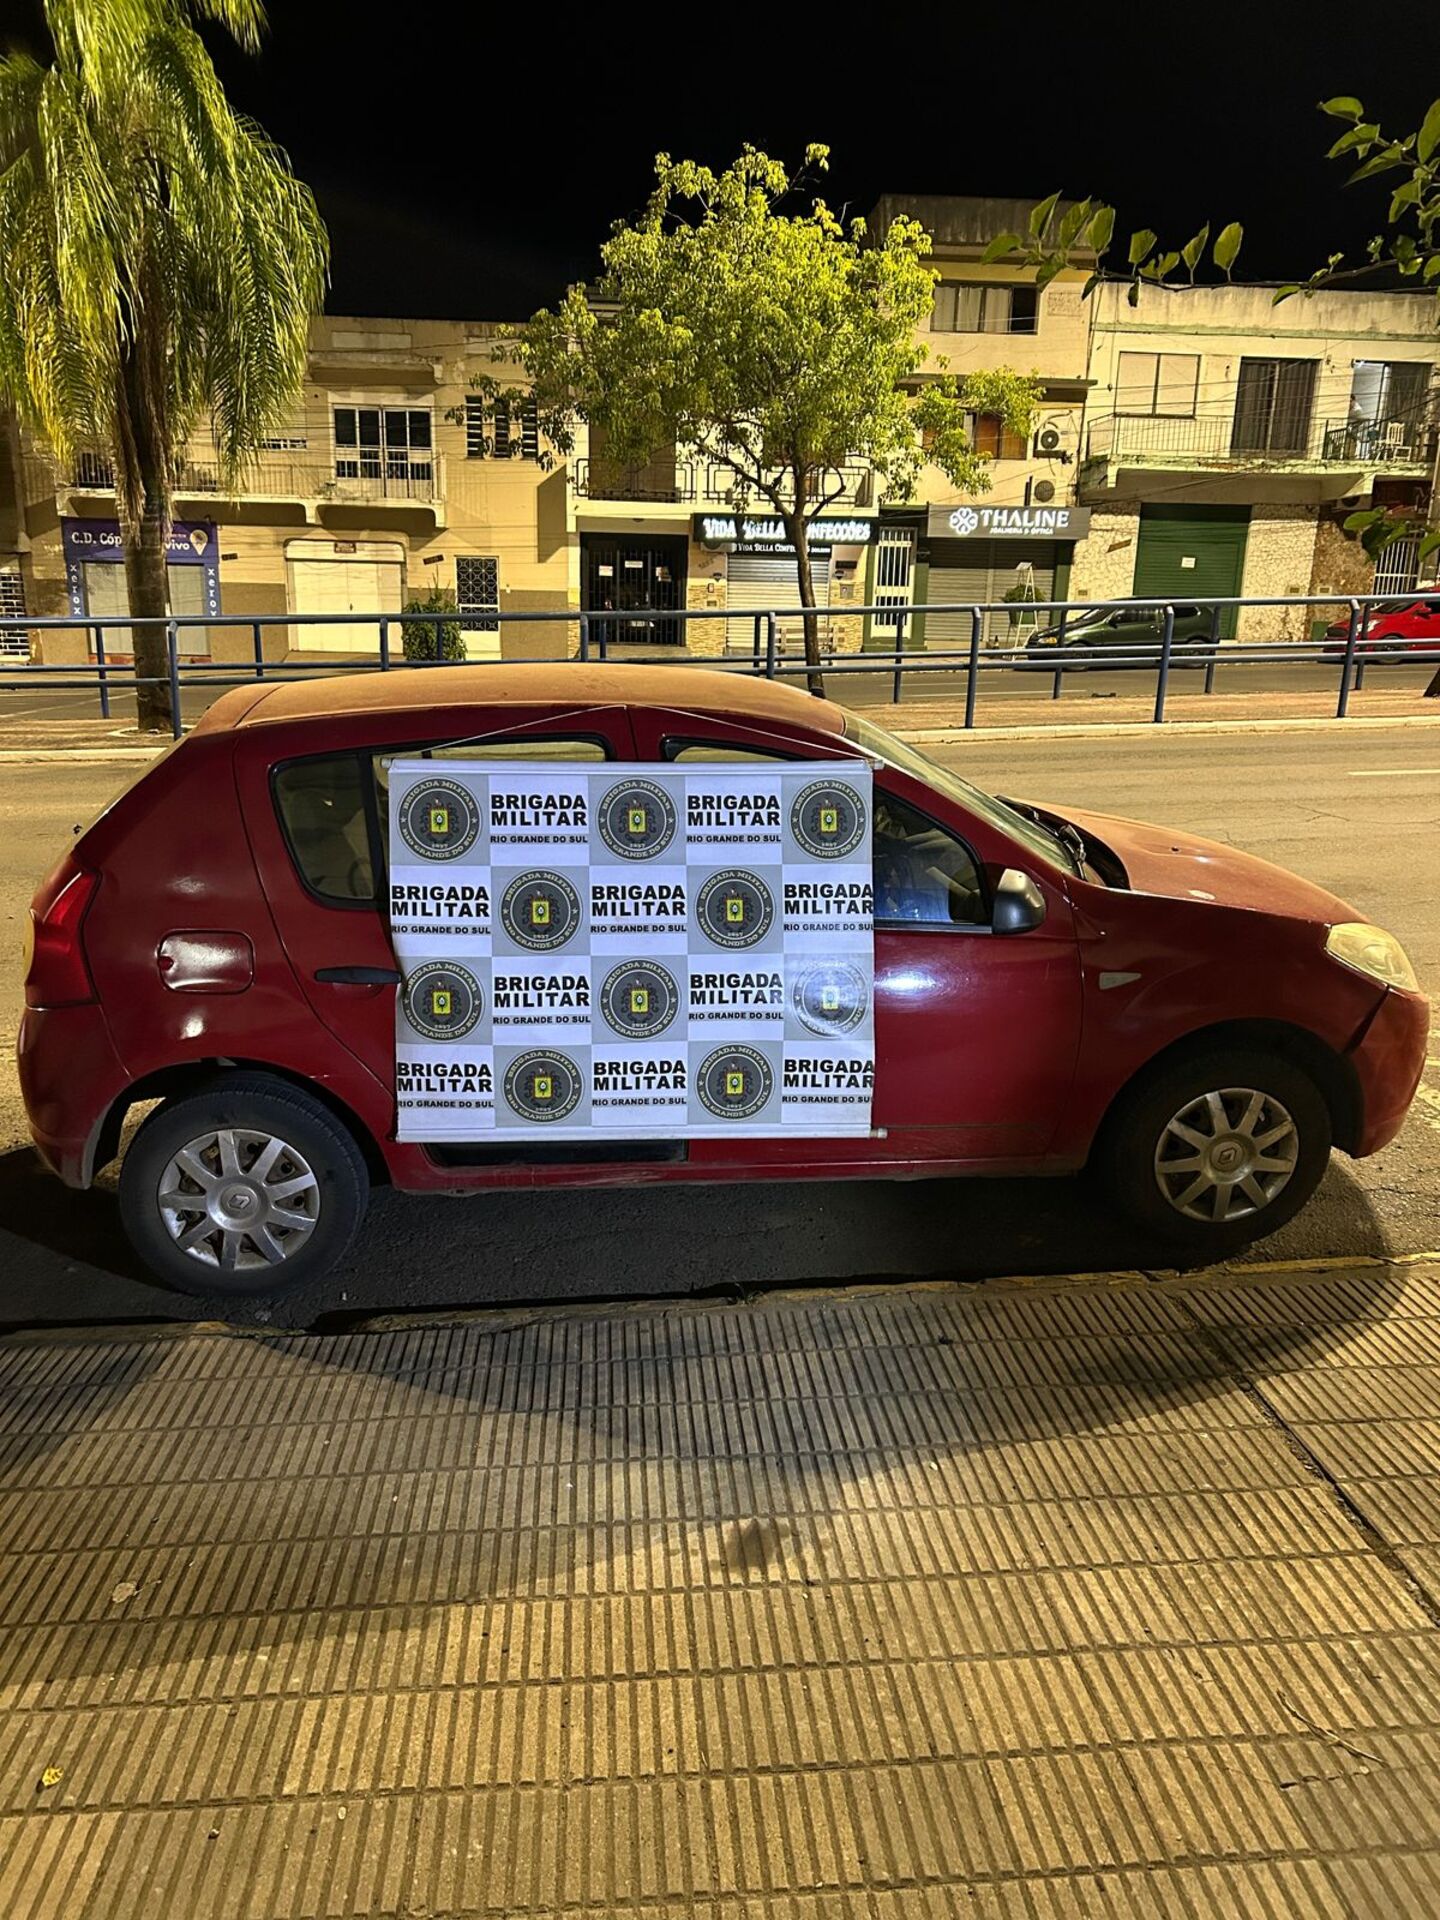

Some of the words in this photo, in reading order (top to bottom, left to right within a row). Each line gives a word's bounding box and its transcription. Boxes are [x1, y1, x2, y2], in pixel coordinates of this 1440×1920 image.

[980, 509, 1069, 527] THALINE
[703, 517, 737, 538] VIDA
[806, 520, 870, 540] NFECÇÕES
[71, 532, 96, 544] C.D.
[99, 532, 123, 546] Cóp
[738, 543, 753, 551] VIDA
[404, 781, 439, 810] BRIGADA
[441, 781, 474, 810] MILITAR
[492, 795, 586, 810] BRIGADA
[604, 782, 637, 810] BRIGADA
[639, 782, 671, 810] MILITAR
[687, 795, 781, 810] BRIGADA
[796, 782, 828, 809] BRIGADA
[830, 782, 861, 809] MILITAR
[492, 811, 587, 826] MILITAR
[687, 811, 781, 826] MILITAR
[490, 835, 507, 844] RIO
[510, 835, 549, 844] GRANDE
[553, 835, 566, 844] DO
[570, 835, 588, 844] SUL
[686, 834, 702, 843] RIO
[706, 834, 744, 843] GRANDE
[748, 834, 760, 843] DO
[764, 834, 782, 843] SUL
[391, 885, 490, 901] BRIGADA
[506, 872, 541, 901] BRIGADA
[543, 872, 575, 901] MILITAR
[592, 885, 686, 900] BRIGADA
[701, 872, 735, 900] BRIGADA
[737, 872, 769, 900] MILITAR
[784, 883, 873, 898] BRIGADA
[392, 901, 490, 917] MILITAR
[592, 901, 686, 917] MILITAR
[784, 899, 873, 914] MILITAR
[391, 925, 408, 934] RIO
[411, 925, 452, 934] GRANDE
[455, 925, 469, 934] DO
[472, 925, 491, 934] SUL
[591, 924, 607, 933] RIO
[610, 924, 648, 933] GRANDE
[652, 924, 665, 933] DO
[668, 924, 687, 933] SUL
[783, 923, 800, 931] RIO
[802, 923, 841, 931] GRANDE
[843, 923, 855, 931] DO
[445, 964, 477, 991] MILITAR
[494, 975, 590, 991] BRIGADA
[606, 963, 639, 990] BRIGADA
[642, 963, 674, 990] MILITAR
[690, 974, 783, 989] BRIGADA
[495, 992, 590, 1008] MILITAR
[690, 990, 782, 1005] MILITAR
[493, 1015, 510, 1025] RIO
[512, 1015, 552, 1025] GRANDE
[555, 1015, 569, 1025] DO
[572, 1015, 591, 1025] SUL
[689, 1012, 705, 1021] RIO
[707, 1012, 747, 1021] GRANDE
[750, 1012, 762, 1021] DO
[765, 1012, 784, 1021] SUL
[509, 1052, 543, 1077] BRIGADA
[545, 1052, 577, 1077] MILITAR
[593, 1060, 686, 1075] BRIGADA
[702, 1047, 735, 1073] BRIGADA
[737, 1047, 769, 1073] MILITAR
[784, 1059, 874, 1073] BRIGADA
[396, 1062, 492, 1078] BRIGADA
[397, 1078, 492, 1093] MILITAR
[593, 1076, 686, 1091] MILITAR
[784, 1074, 874, 1088] MILITAR
[416, 1100, 456, 1108] GRANDE
[459, 1100, 472, 1108] DO
[475, 1100, 494, 1108] SUL
[591, 1097, 608, 1106] RIO
[611, 1097, 649, 1106] GRANDE
[653, 1097, 666, 1106] DO
[669, 1097, 687, 1106] SUL
[782, 1095, 798, 1103] RIO
[801, 1095, 839, 1103] GRANDE
[842, 1095, 855, 1103] DO
[858, 1095, 871, 1103] SU
